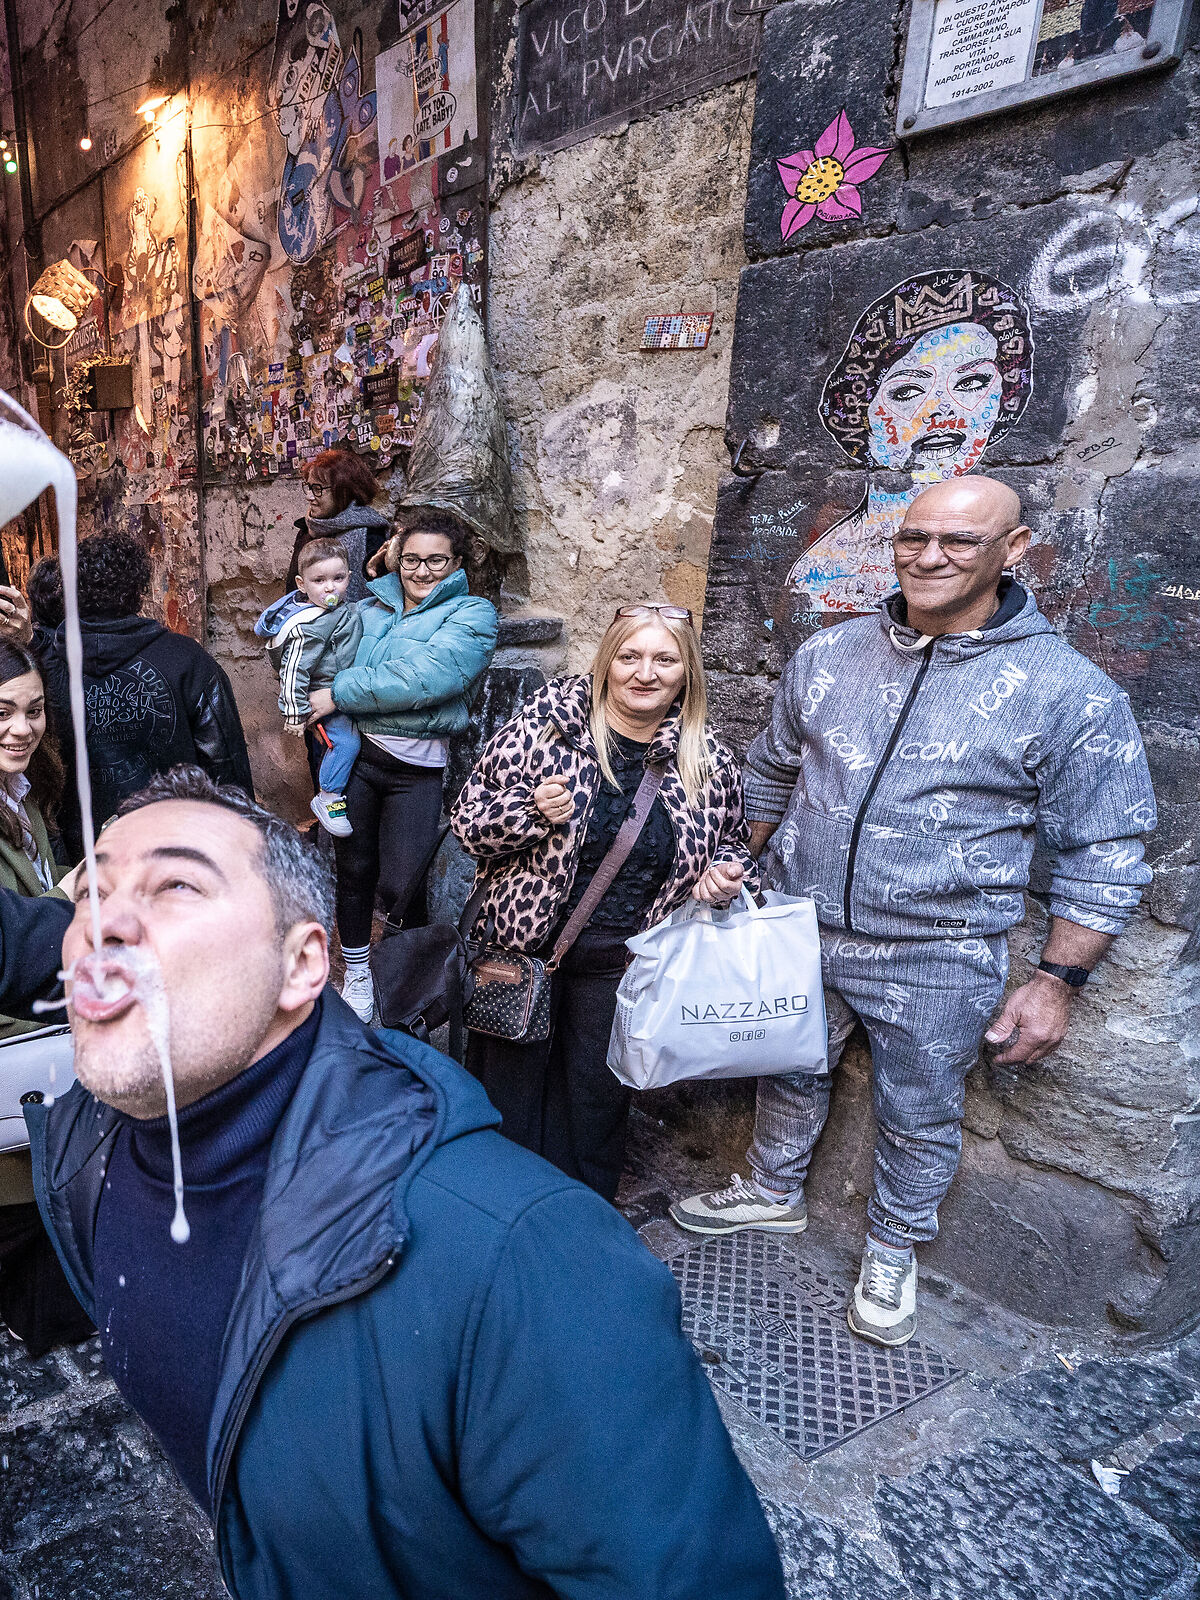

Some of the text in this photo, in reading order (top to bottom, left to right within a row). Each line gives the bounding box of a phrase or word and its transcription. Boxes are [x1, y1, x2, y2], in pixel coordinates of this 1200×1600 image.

[938, 23, 954, 35] DEL
[954, 15, 982, 31] CUORE
[983, 11, 994, 23] DI
[943, 15, 952, 24] IN
[953, 3, 989, 21] QUESTO
[531, 0, 607, 57] VICO
[938, 26, 1022, 60] TRASCORSE LA SUA
[968, 47, 987, 60] VITA
[520, 0, 762, 129] AL PVRGATO
[953, 52, 1000, 73] PORTANDO
[934, 72, 964, 87] NAPOLI
[965, 67, 982, 80] NEL
[951, 80, 994, 99] 1914-2002
[433, 95, 446, 113] TOO
[968, 662, 1028, 720] ICON
[823, 725, 875, 770] ICON
[681, 994, 808, 1021] NAZZARO
[887, 1222, 907, 1231] ICON
